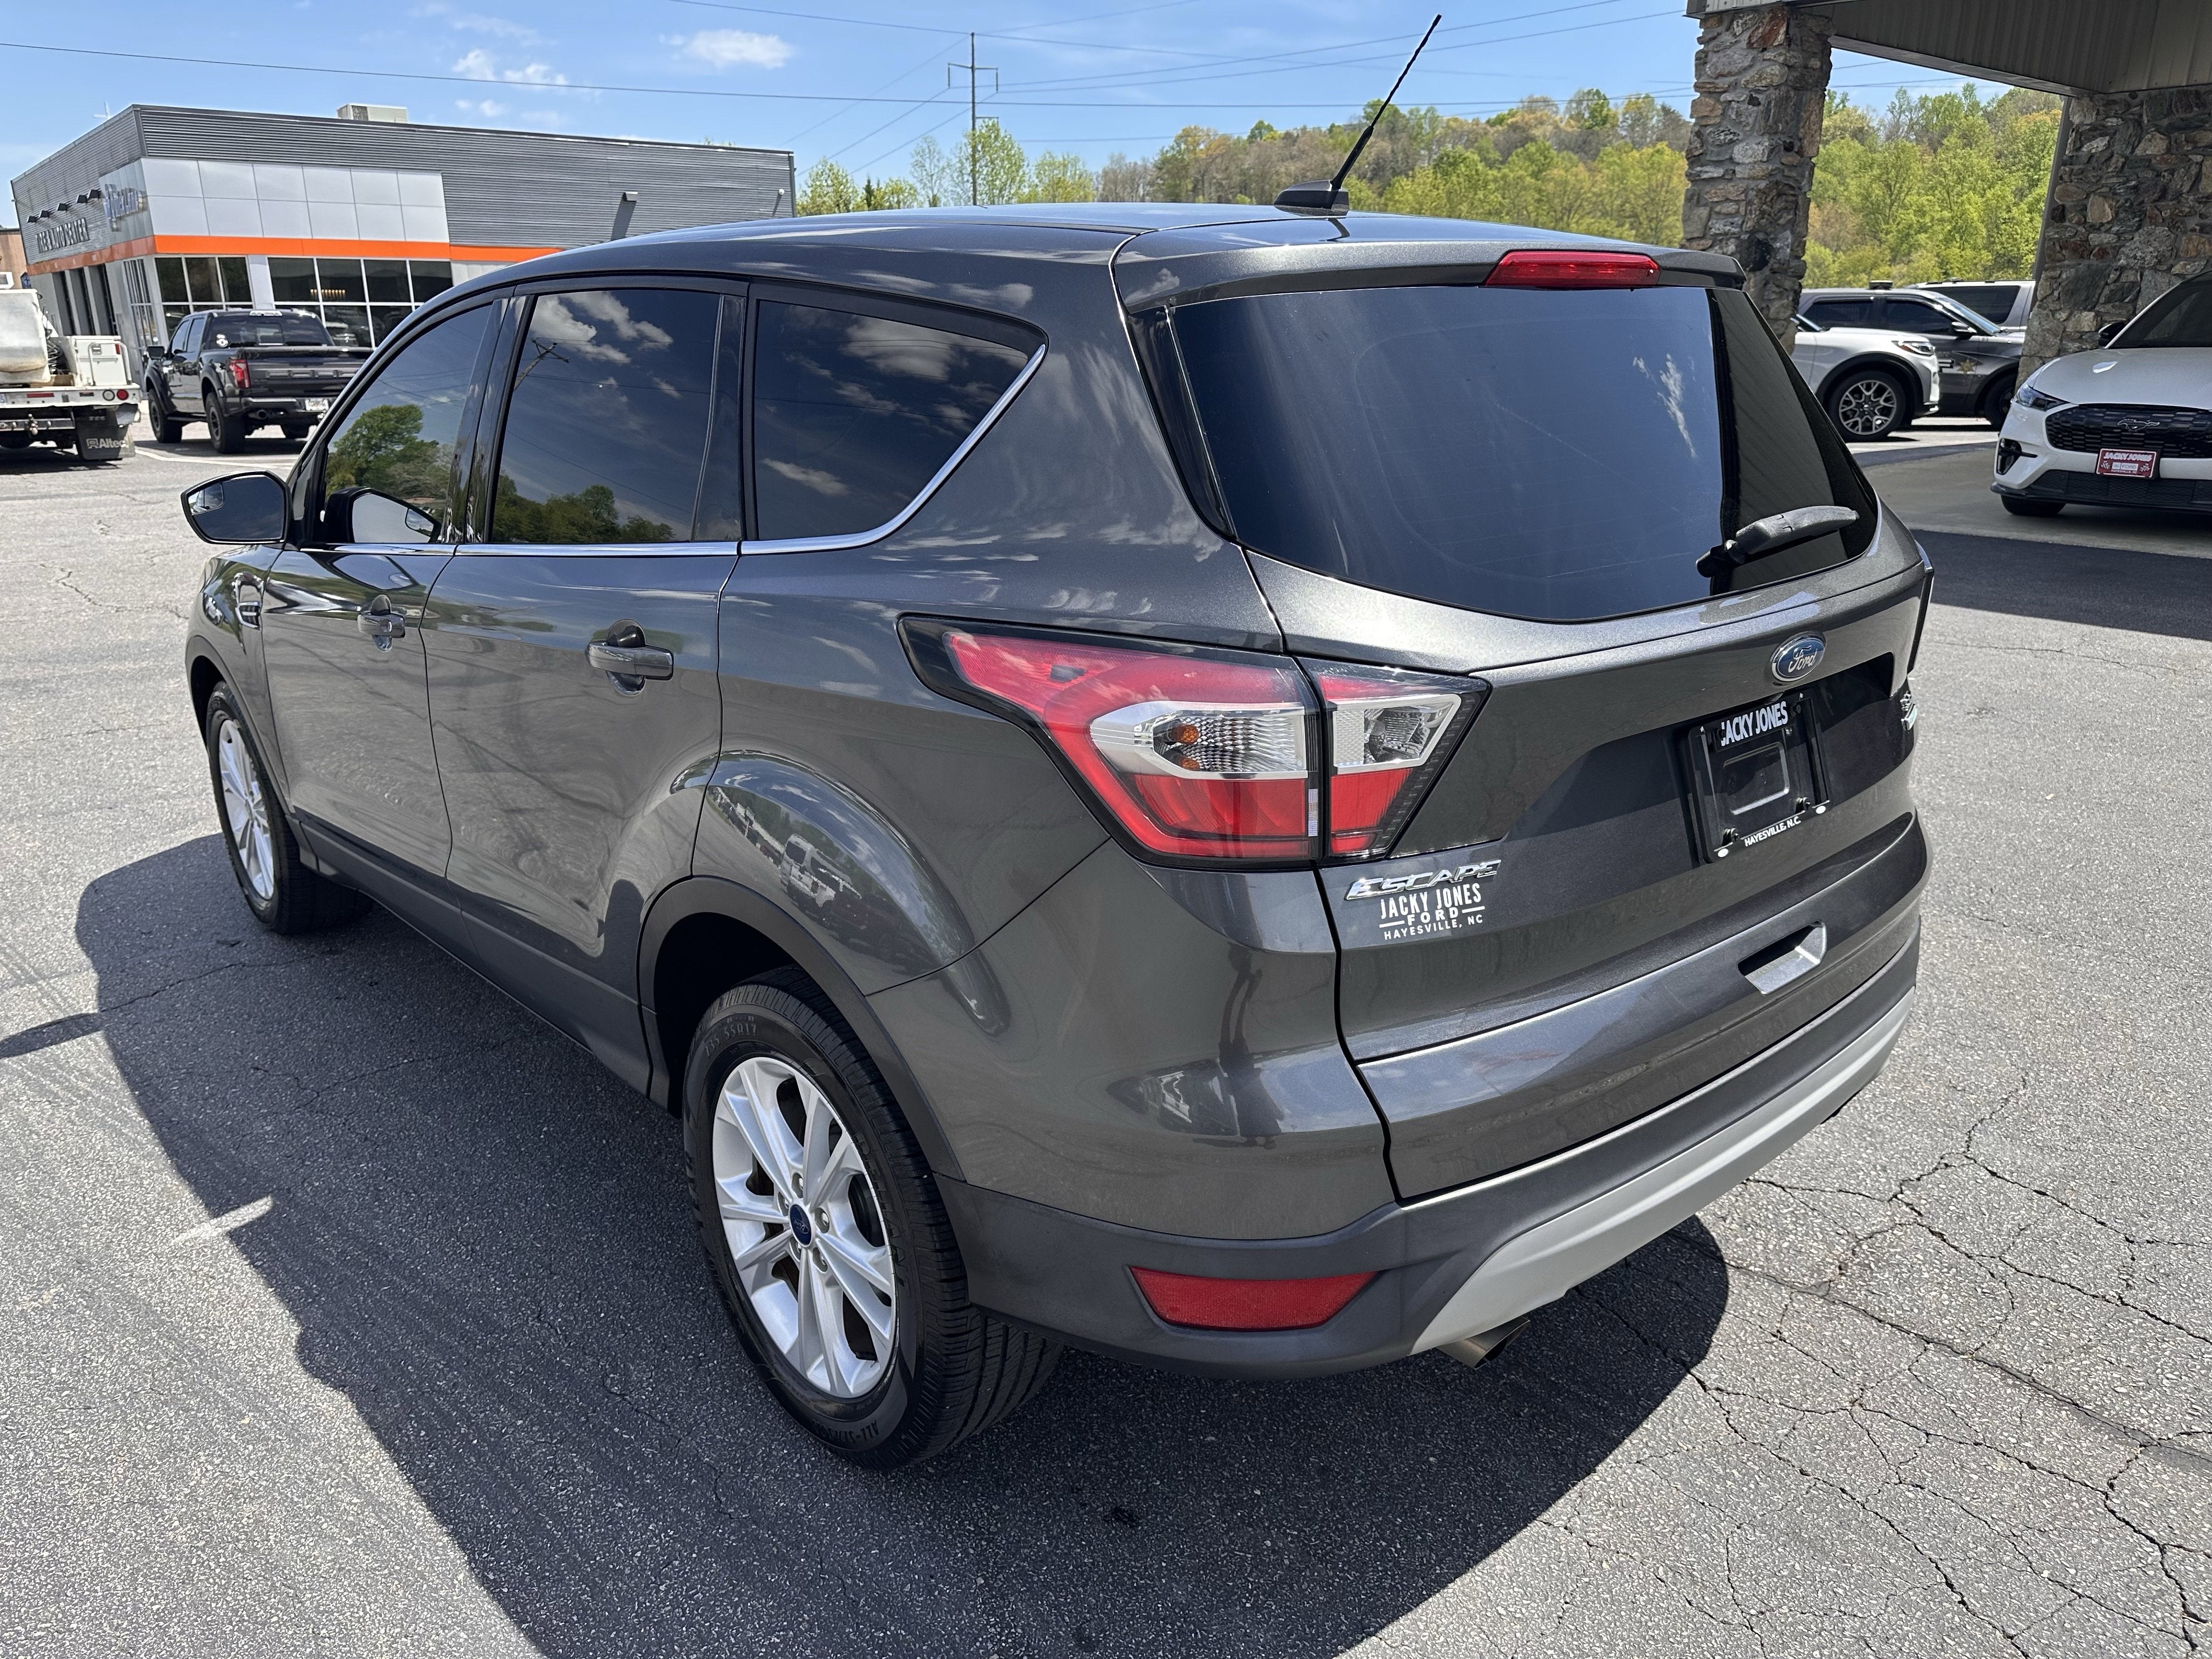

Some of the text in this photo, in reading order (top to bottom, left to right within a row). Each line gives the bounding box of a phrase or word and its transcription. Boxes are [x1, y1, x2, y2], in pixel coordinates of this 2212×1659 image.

[1788, 645, 1818, 673] Ford
[1720, 701, 1788, 747] JACKY JONES
[1344, 859, 1502, 901] ESCAPE
[1380, 883, 1482, 919] JACKY JONES
[1407, 907, 1459, 926] FORD
[1384, 914, 1483, 940] HAYESVILLE, NC
